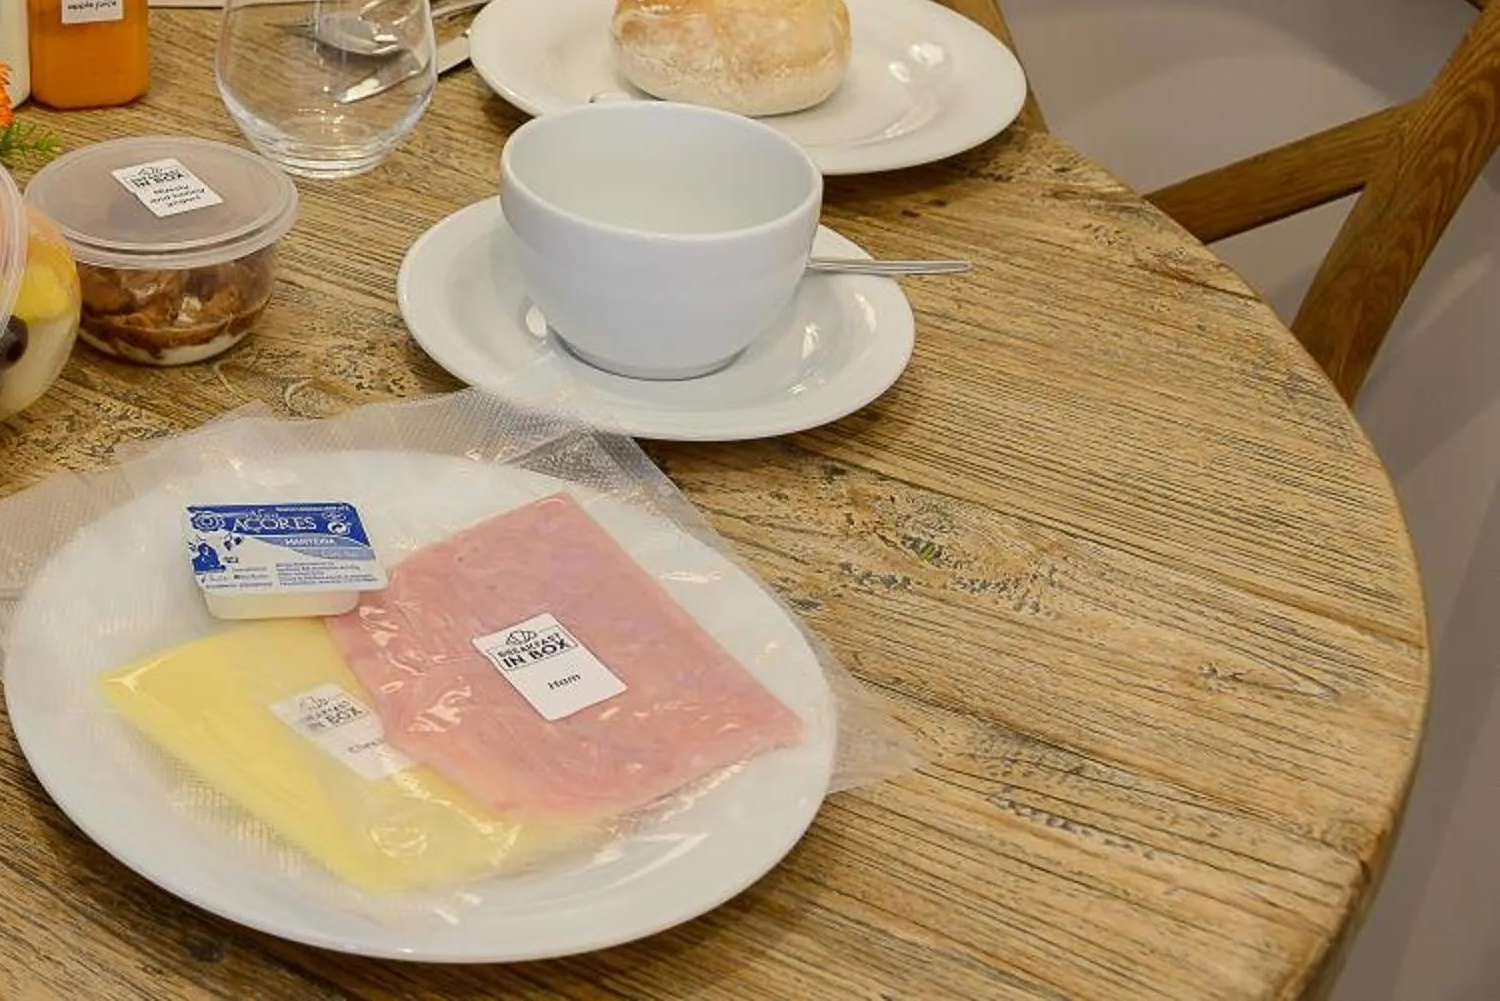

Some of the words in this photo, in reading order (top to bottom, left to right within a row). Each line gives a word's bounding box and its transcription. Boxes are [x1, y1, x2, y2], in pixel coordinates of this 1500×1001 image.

[233, 516, 318, 534] AÇORES
[498, 631, 561, 658] BREAKFAST
[502, 654, 527, 668] IN
[528, 638, 570, 661] BOX
[547, 673, 582, 691] Ham
